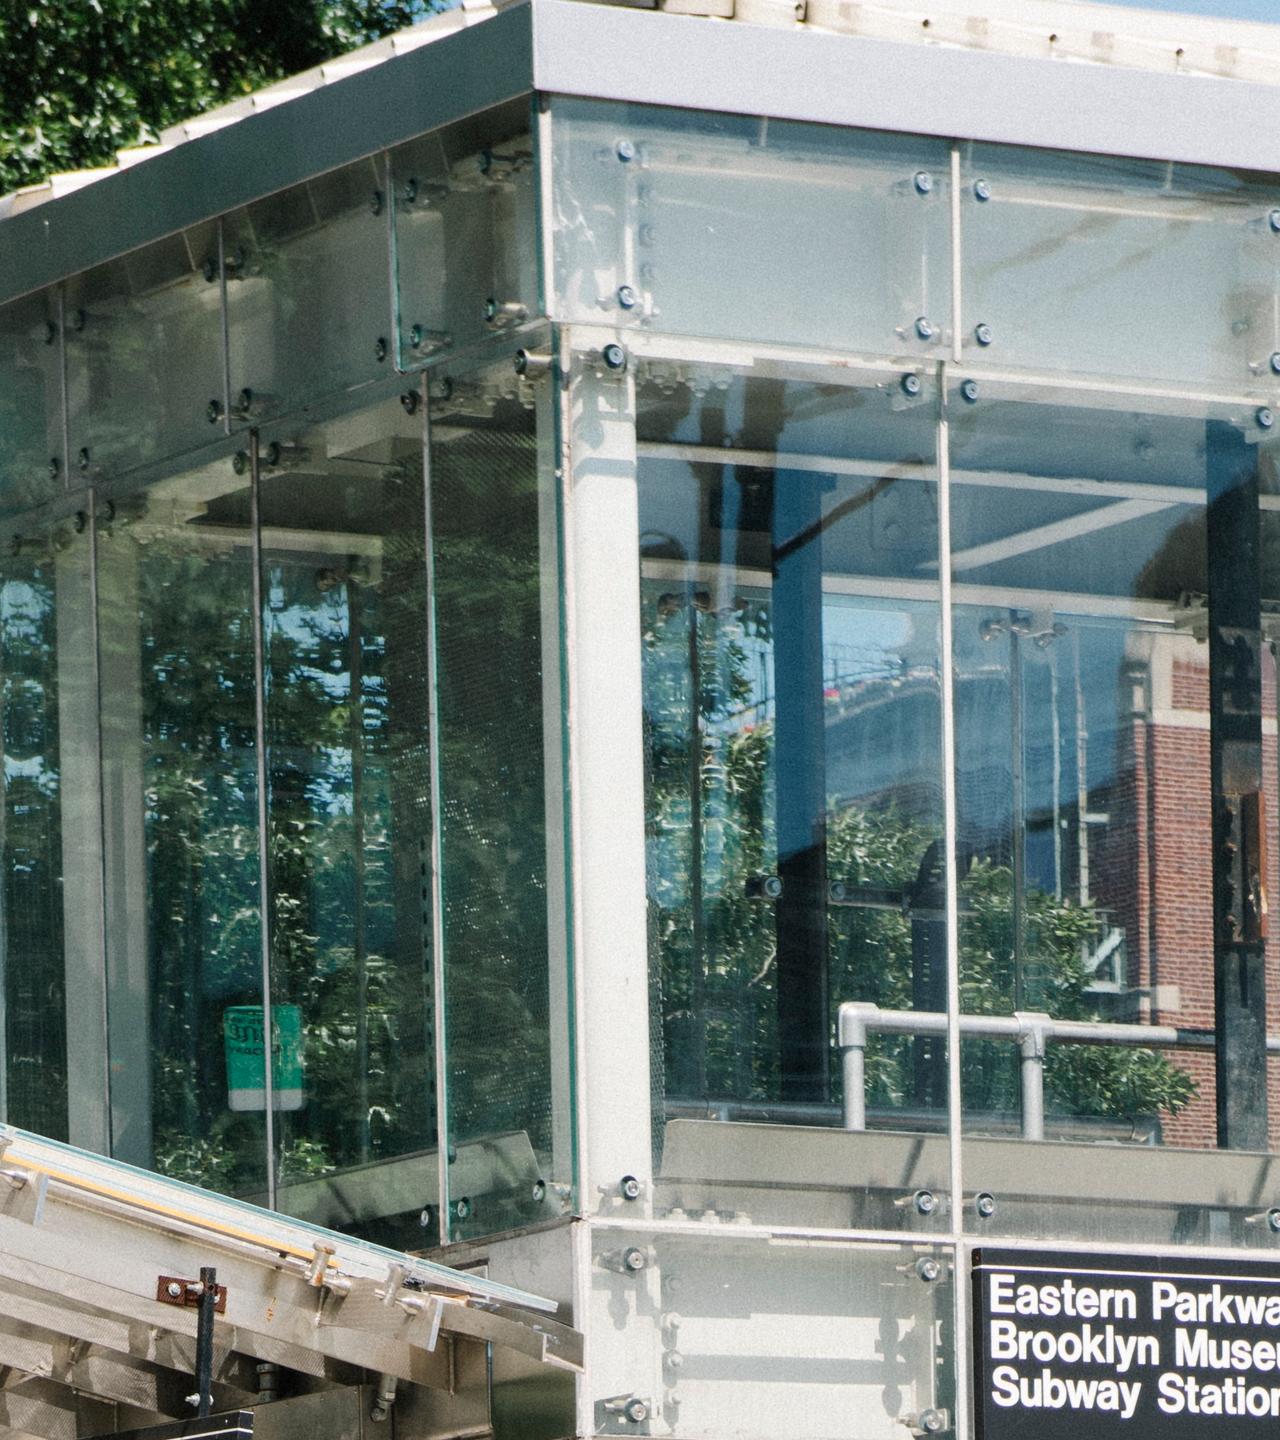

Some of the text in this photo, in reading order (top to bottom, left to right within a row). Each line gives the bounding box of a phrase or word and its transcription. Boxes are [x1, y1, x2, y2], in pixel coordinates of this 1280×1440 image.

[990, 1273, 1136, 1319] Eastern
[990, 1320, 1159, 1372] Brooklyn
[992, 1366, 1141, 1419] Subway
